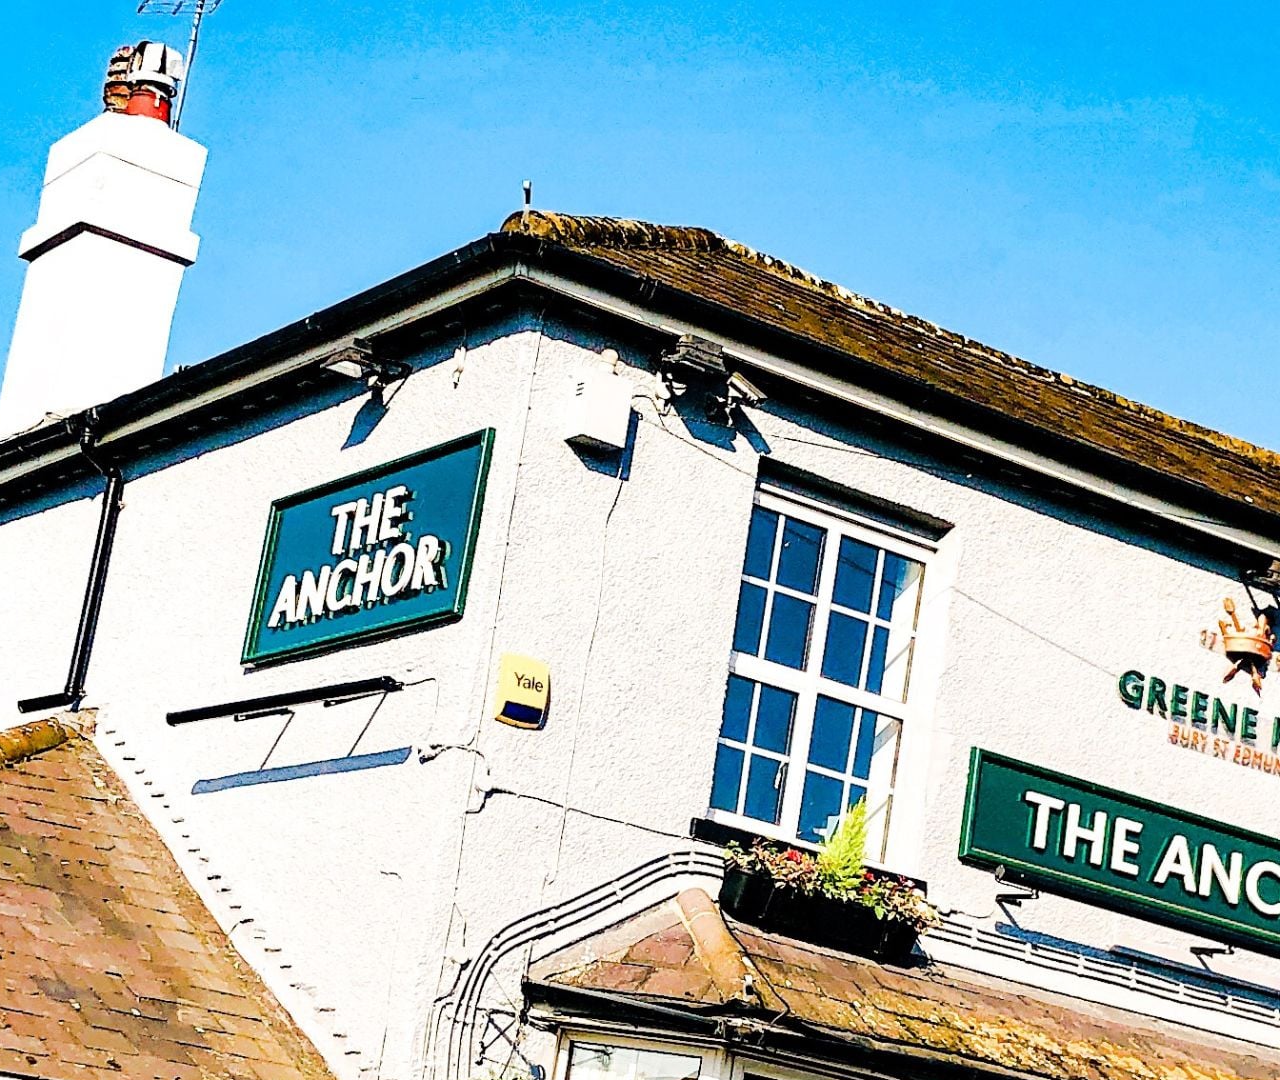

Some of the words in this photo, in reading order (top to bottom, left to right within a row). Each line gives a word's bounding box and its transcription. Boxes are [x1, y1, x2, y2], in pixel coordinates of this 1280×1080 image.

[331, 485, 408, 555] THE
[267, 535, 440, 628] ANCHOR
[513, 671, 544, 693] Yale
[1118, 670, 1258, 742] GREENE
[1169, 724, 1208, 753] BURY
[1213, 737, 1230, 761] ST
[1025, 790, 1143, 876] THE
